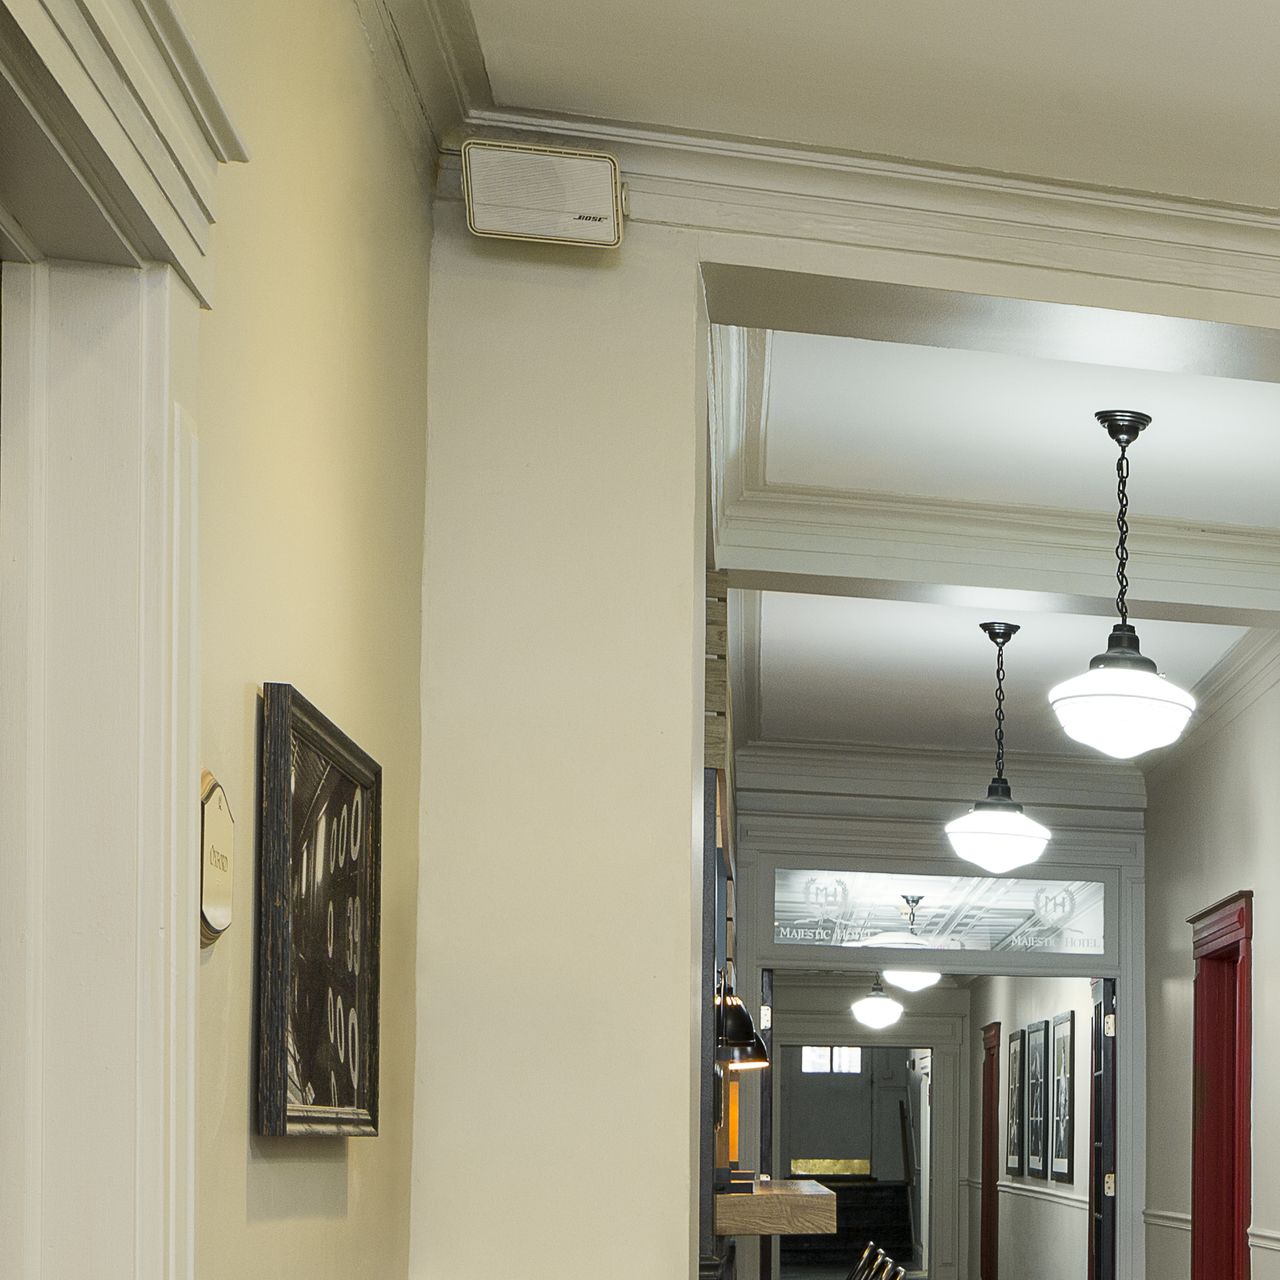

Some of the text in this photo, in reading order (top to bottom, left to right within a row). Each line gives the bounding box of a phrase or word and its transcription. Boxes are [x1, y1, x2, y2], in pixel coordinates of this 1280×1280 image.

[573, 215, 608, 223] BOSE
[780, 927, 832, 940] MAJESTIC
[1011, 936, 1059, 947] MAJESTIC
